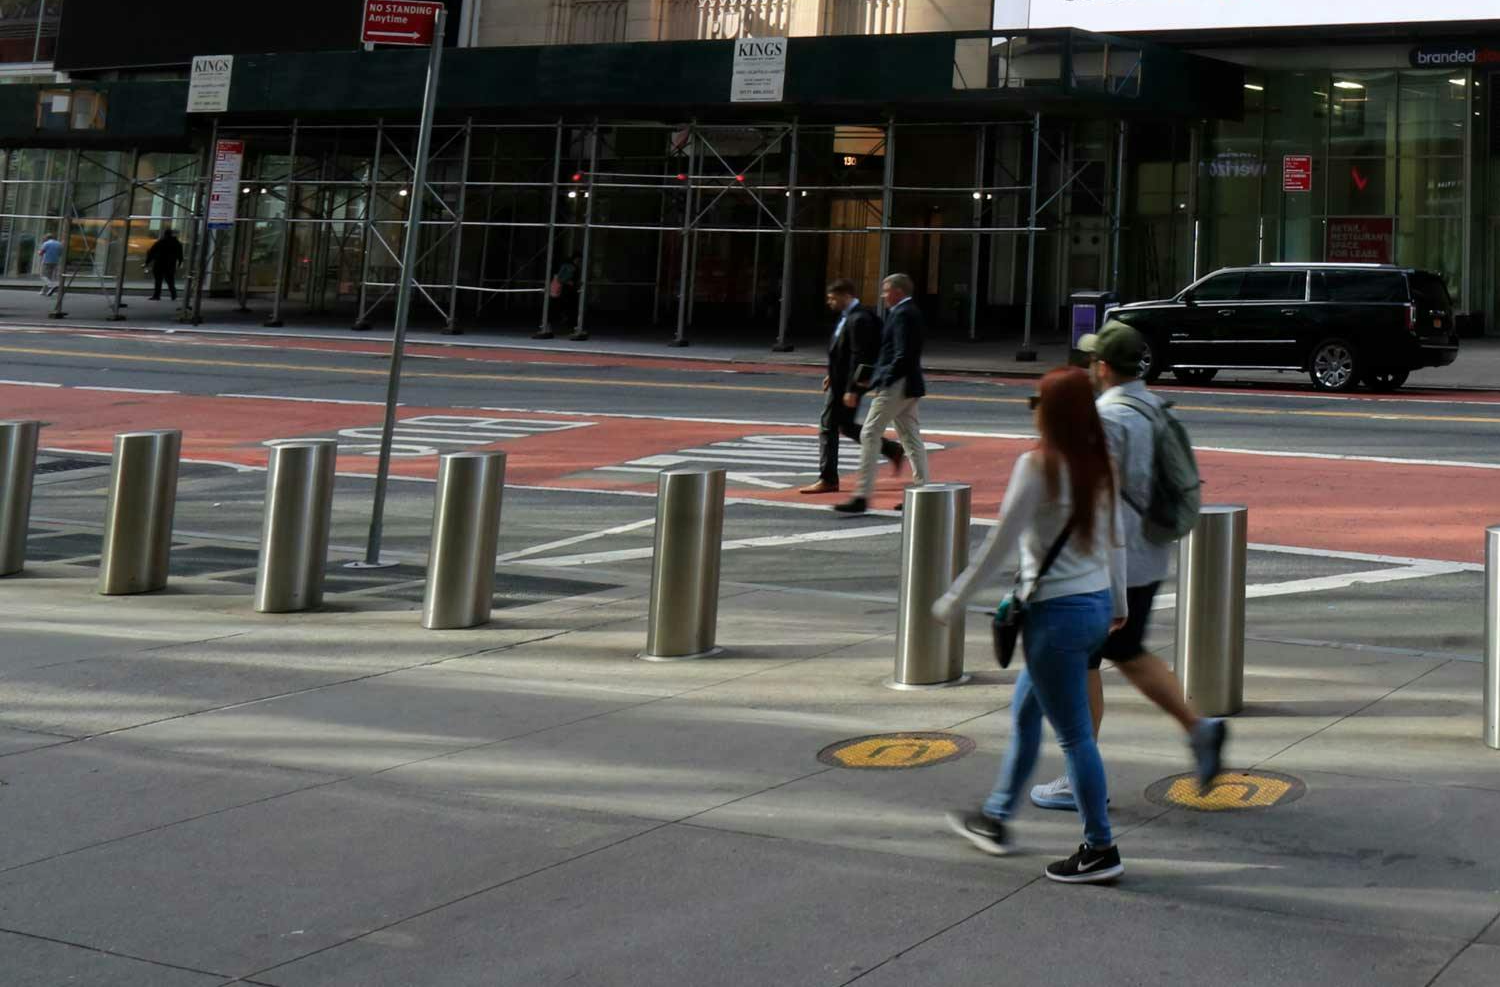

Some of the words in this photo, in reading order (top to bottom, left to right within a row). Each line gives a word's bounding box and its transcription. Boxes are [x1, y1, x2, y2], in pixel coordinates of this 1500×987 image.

[369, 3, 383, 12] NO
[385, 4, 433, 15] STANDING
[368, 14, 409, 24] Anytime
[739, 42, 783, 57] KINGS
[195, 59, 230, 72] KINGS
